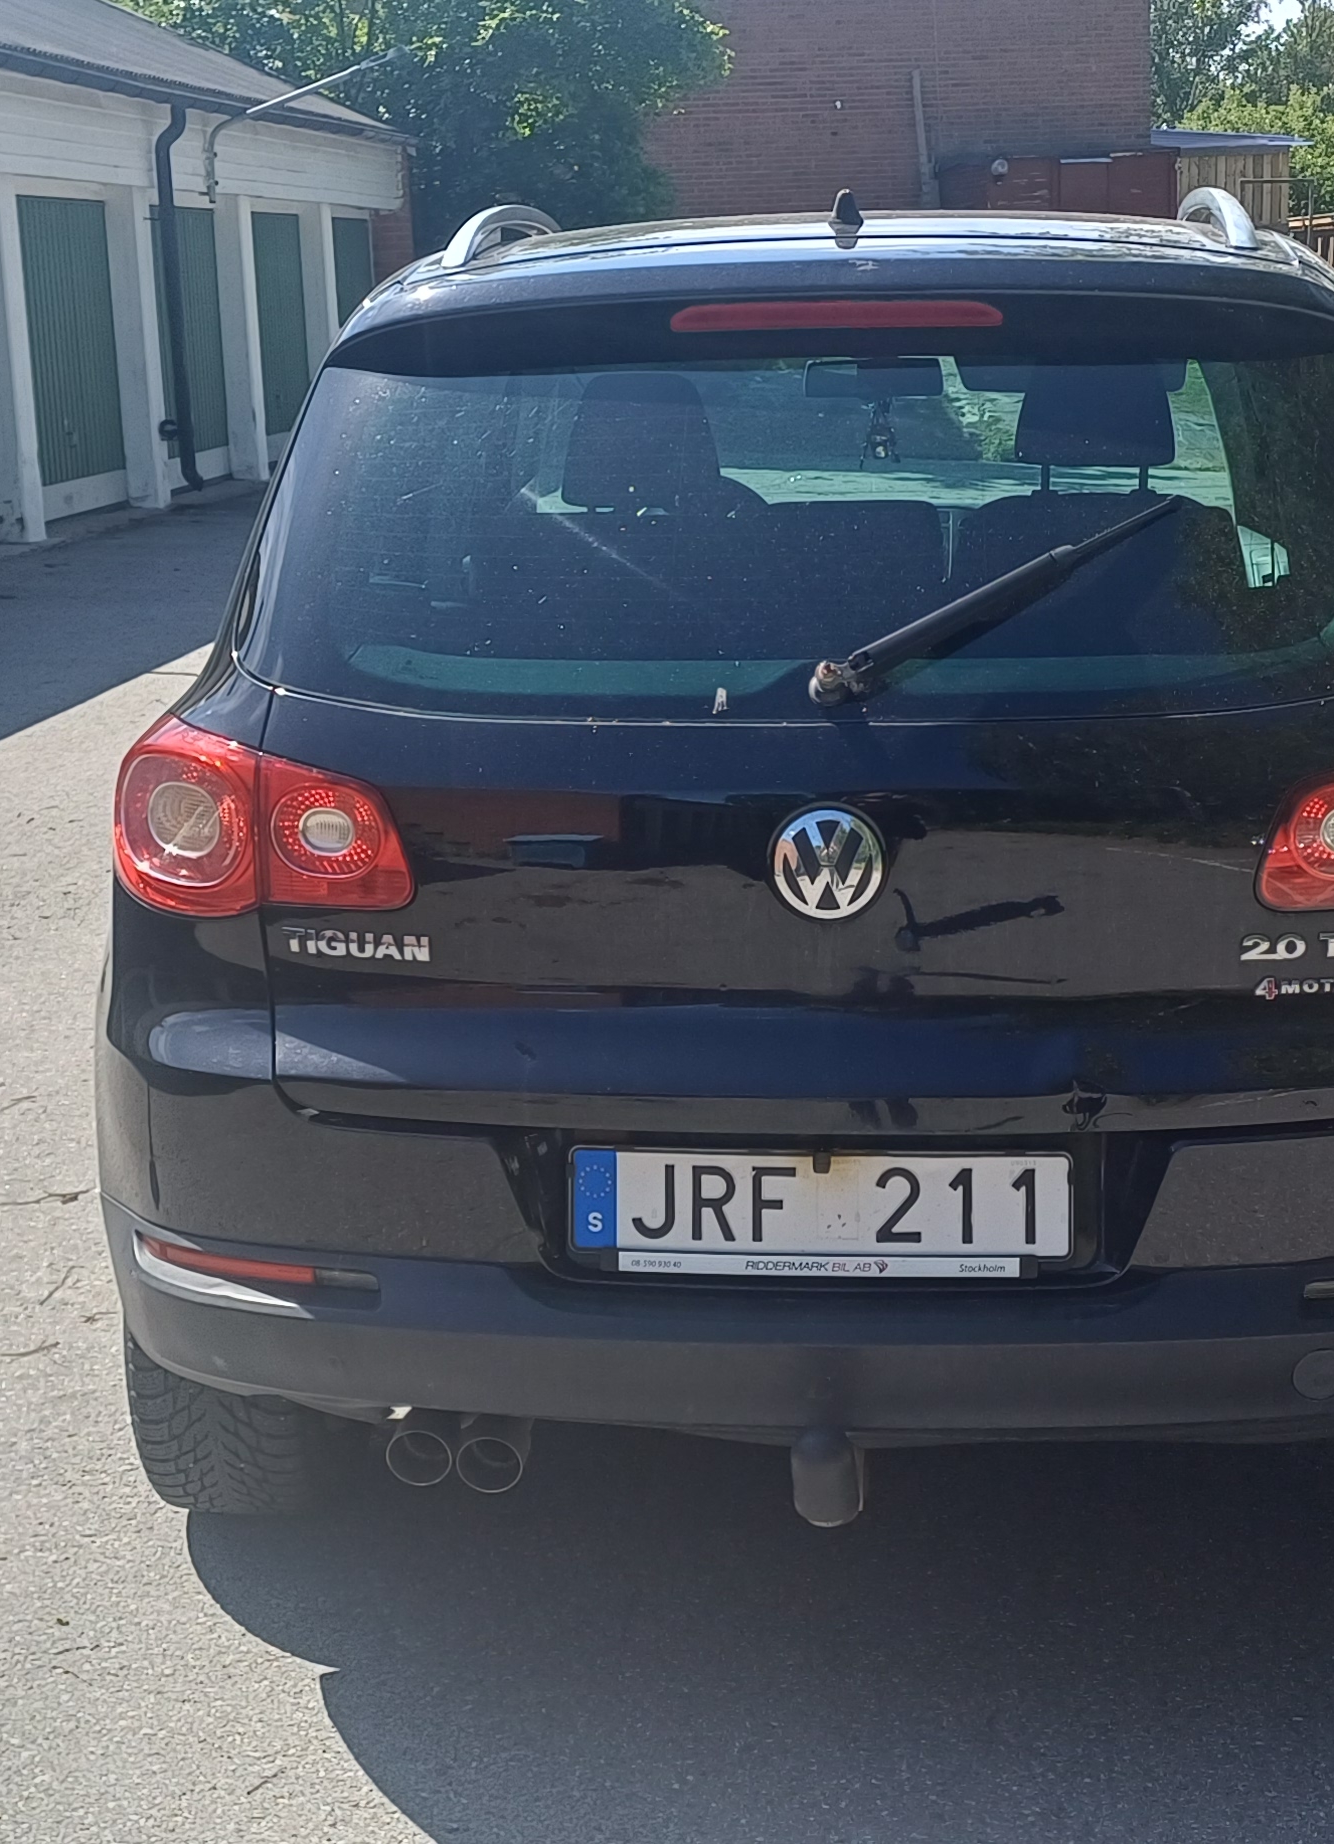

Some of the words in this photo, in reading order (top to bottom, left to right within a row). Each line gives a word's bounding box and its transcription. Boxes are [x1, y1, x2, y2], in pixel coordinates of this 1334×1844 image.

[281, 926, 431, 962] TIGUAN
[631, 1163, 797, 1243] JRF
[875, 1166, 1037, 1246] 211
[587, 1212, 603, 1233] S
[744, 1260, 830, 1273] RIDDERMARK
[831, 1262, 850, 1273] BIL
[852, 1262, 872, 1273] AB
[958, 1263, 1006, 1273] Stockholm
